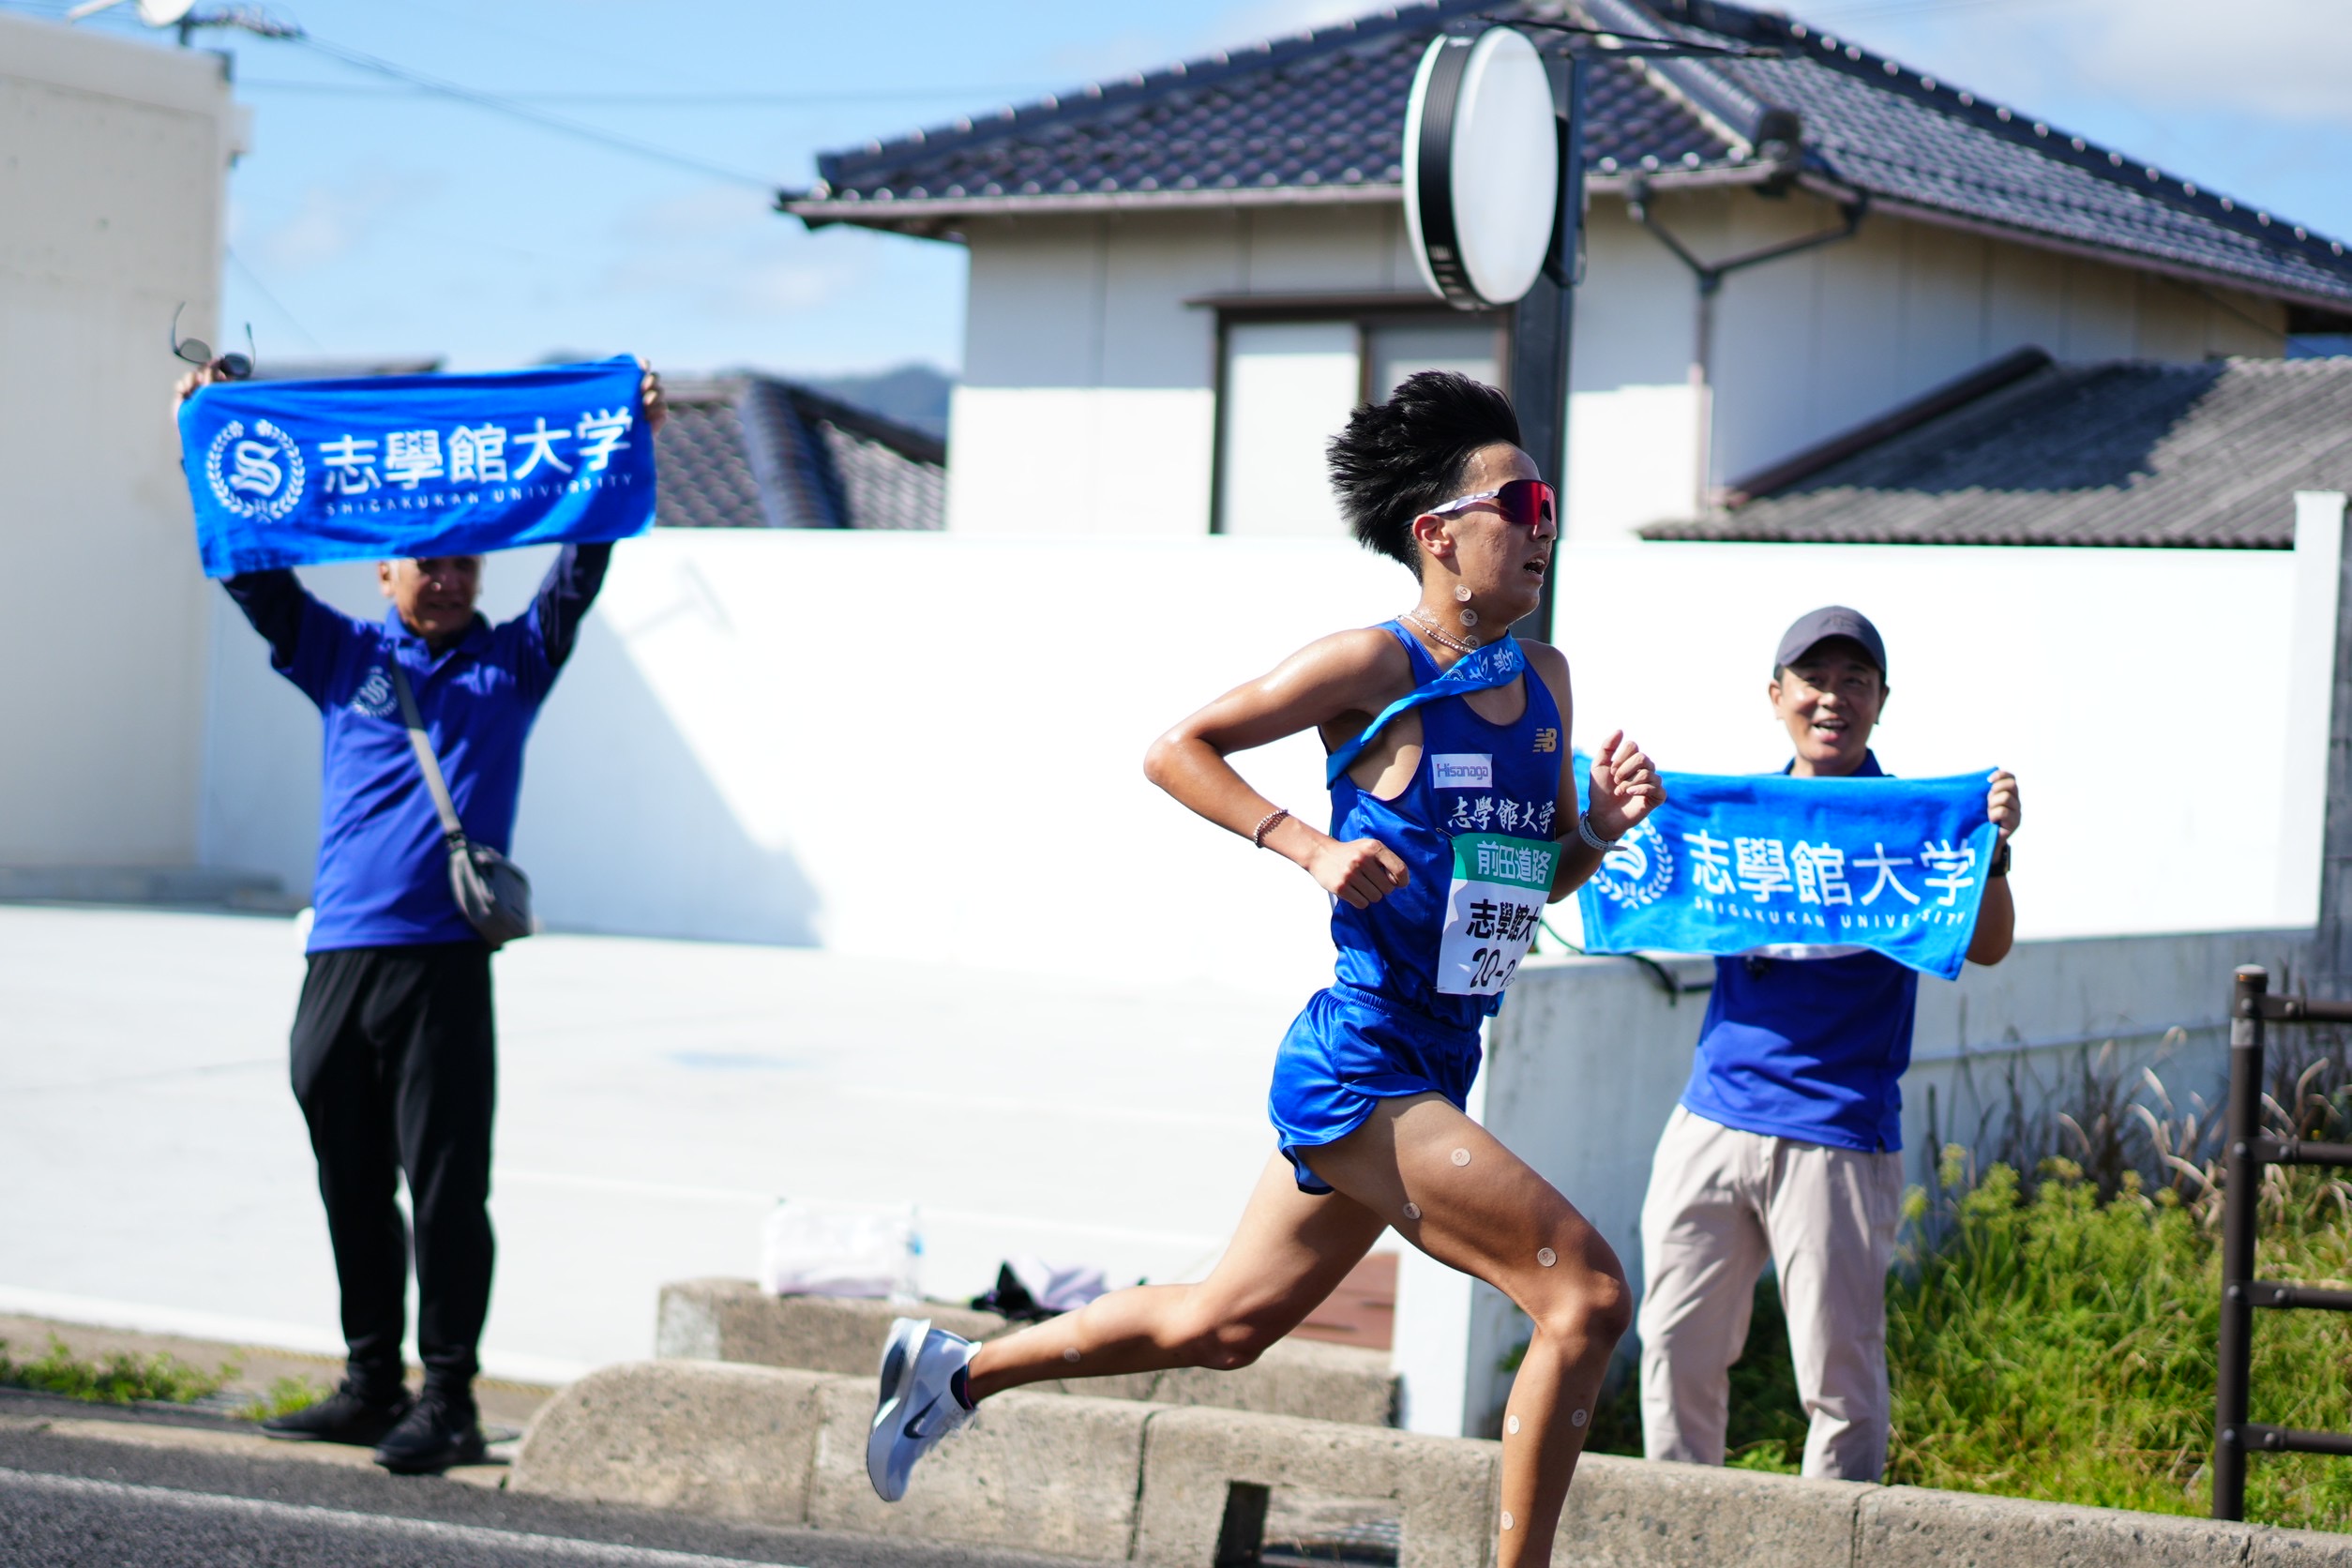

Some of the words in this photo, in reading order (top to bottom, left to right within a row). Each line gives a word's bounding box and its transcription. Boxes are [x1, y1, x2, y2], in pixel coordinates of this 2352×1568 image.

[318, 406, 633, 495] 志學館大学
[325, 493, 479, 516] SHIGAKUKAN
[493, 474, 633, 503] UNIVERSITY
[1437, 762, 1489, 780] Hisanaga
[1447, 795, 1557, 834] 志學館大学
[1477, 840, 1552, 884] 前田道路
[1682, 828, 1976, 908] 志學館大学
[1695, 896, 1826, 927] SHIGAKUKAN
[1840, 908, 1967, 929] UNIVESITY
